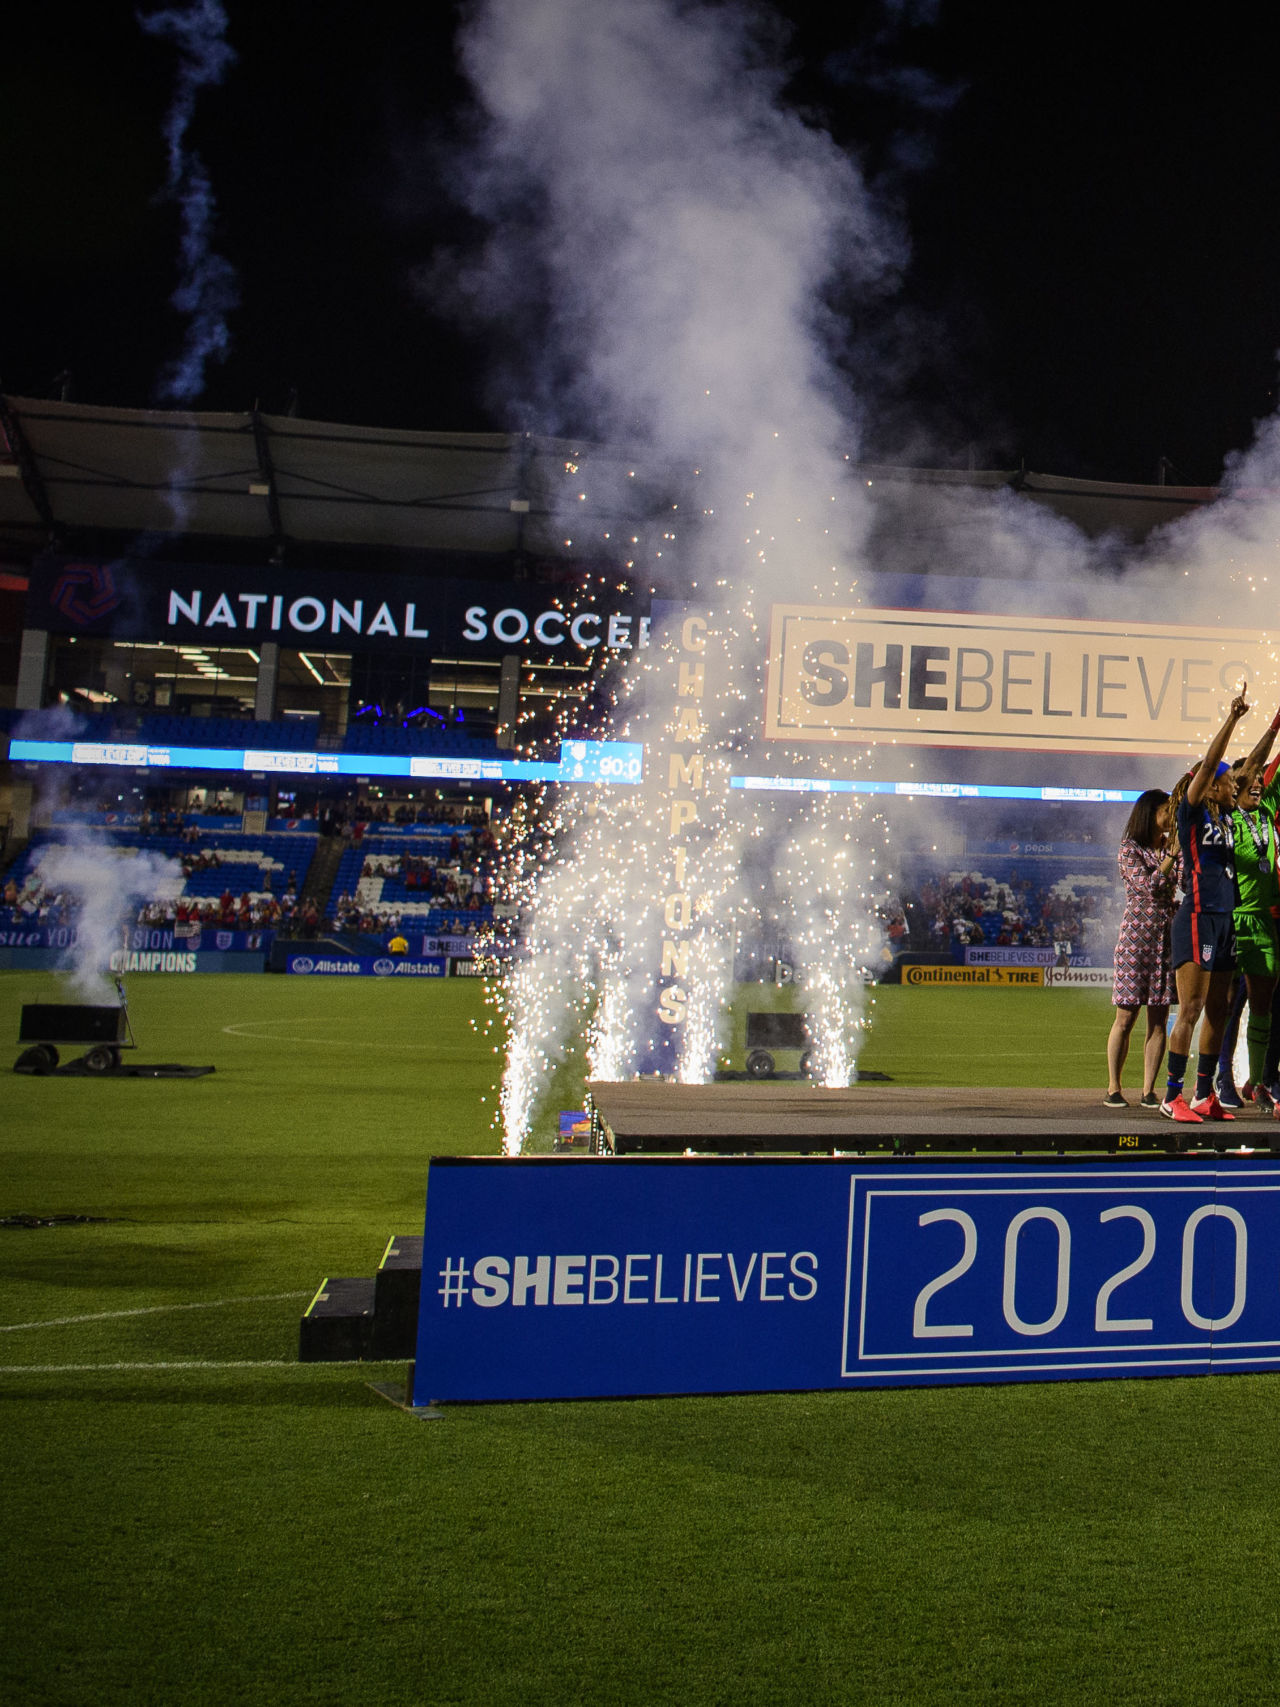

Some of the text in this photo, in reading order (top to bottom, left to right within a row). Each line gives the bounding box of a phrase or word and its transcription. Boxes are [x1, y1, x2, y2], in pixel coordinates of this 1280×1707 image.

[168, 590, 429, 638] NATIONAL
[799, 640, 1254, 724] SHEBELIEVES
[658, 616, 707, 1026] CHAMPIONS
[1202, 823, 1222, 845] 22
[314, 957, 440, 974] Allstate Allstate
[969, 949, 1056, 963] SHEBELIEVES CUP
[907, 967, 1039, 985] Continental TIRE
[1046, 966, 1108, 987] Johnson
[1119, 1136, 1139, 1147] PSI
[438, 1251, 818, 1309] #SHEBELIEVES
[912, 1204, 1247, 1338] 2020
